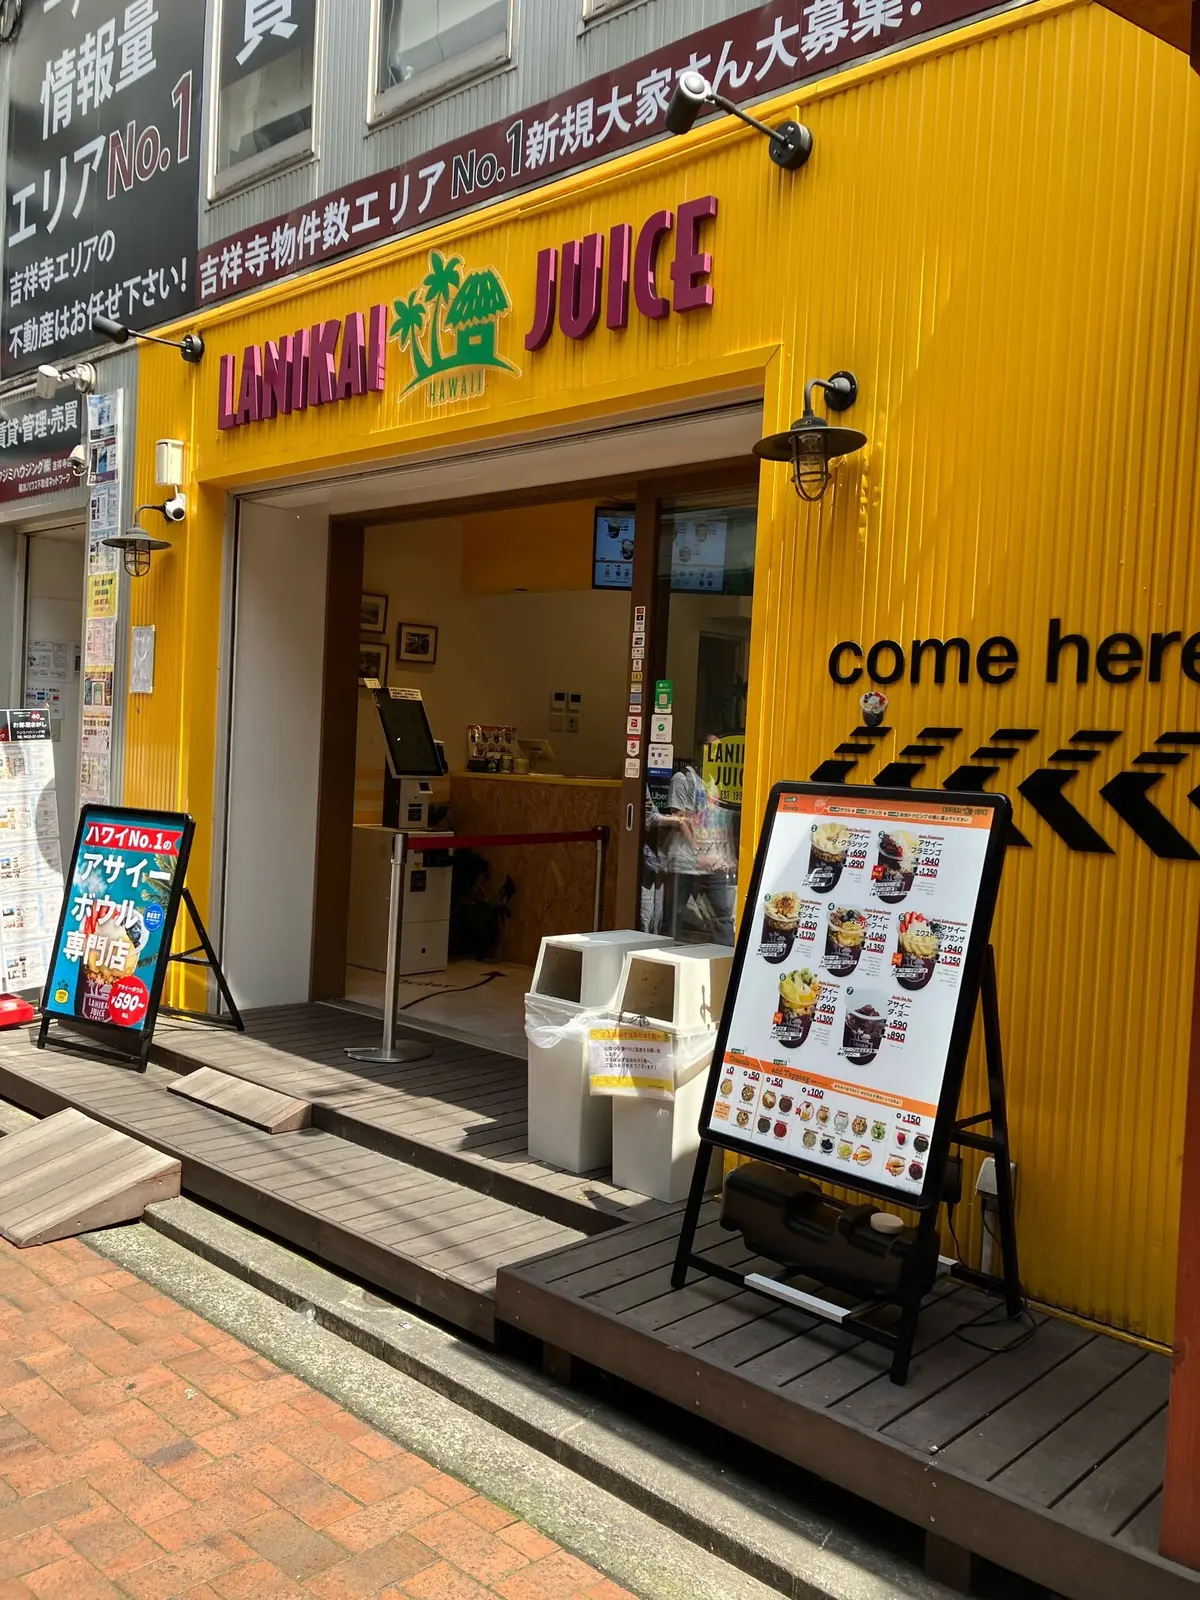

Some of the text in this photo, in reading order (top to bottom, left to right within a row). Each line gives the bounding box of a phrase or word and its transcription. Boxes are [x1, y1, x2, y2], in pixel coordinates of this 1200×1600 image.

[40, 0, 158, 140] 情報量
[199, 0, 922, 301] 吉祥寺物件数エリアNo.1新規大家ん大募集
[8, 69, 194, 247] エリアNo.1
[9, 230, 115, 308] 吉祥寺エリアの
[8, 257, 187, 359] 不動産はお任せ下さい！
[218, 195, 718, 430] LANIKAI JUICE
[430, 371, 481, 403] HAWAII
[828, 636, 1018, 685] come
[708, 743, 745, 764] LANI
[651, 792, 668, 800] Uber
[85, 825, 172, 850] ハワイNo.1の
[832, 839, 869, 848] ダ・クラシック
[918, 840, 943, 848] アサイー
[850, 849, 867, 858] ¥690
[911, 847, 942, 857] フラミンゴ
[848, 859, 865, 867] ¥990
[921, 857, 940, 866] ¥940
[81, 852, 171, 888] アサイー
[71, 892, 139, 929] ボウル
[799, 904, 820, 912] アサイー
[798, 911, 819, 919] モンキー
[867, 913, 890, 922] アサイー
[802, 920, 818, 929] ¥820
[851, 919, 888, 930] スーパーフード
[941, 924, 966, 933] アサイー
[63, 930, 131, 972] 専門店
[944, 944, 963, 954] ¥940
[117, 984, 144, 994] アサイーボウル
[817, 985, 839, 994] アサイー
[814, 994, 838, 1003] カナリア
[820, 1003, 836, 1013] ¥990
[887, 999, 911, 1010] アサイー
[90, 1007, 105, 1017] JUICE
[887, 1009, 909, 1018] ダ・ヌー
[890, 1019, 908, 1030] ¥590
[887, 1031, 906, 1041] ¥890
[784, 1068, 810, 1083] Topping
